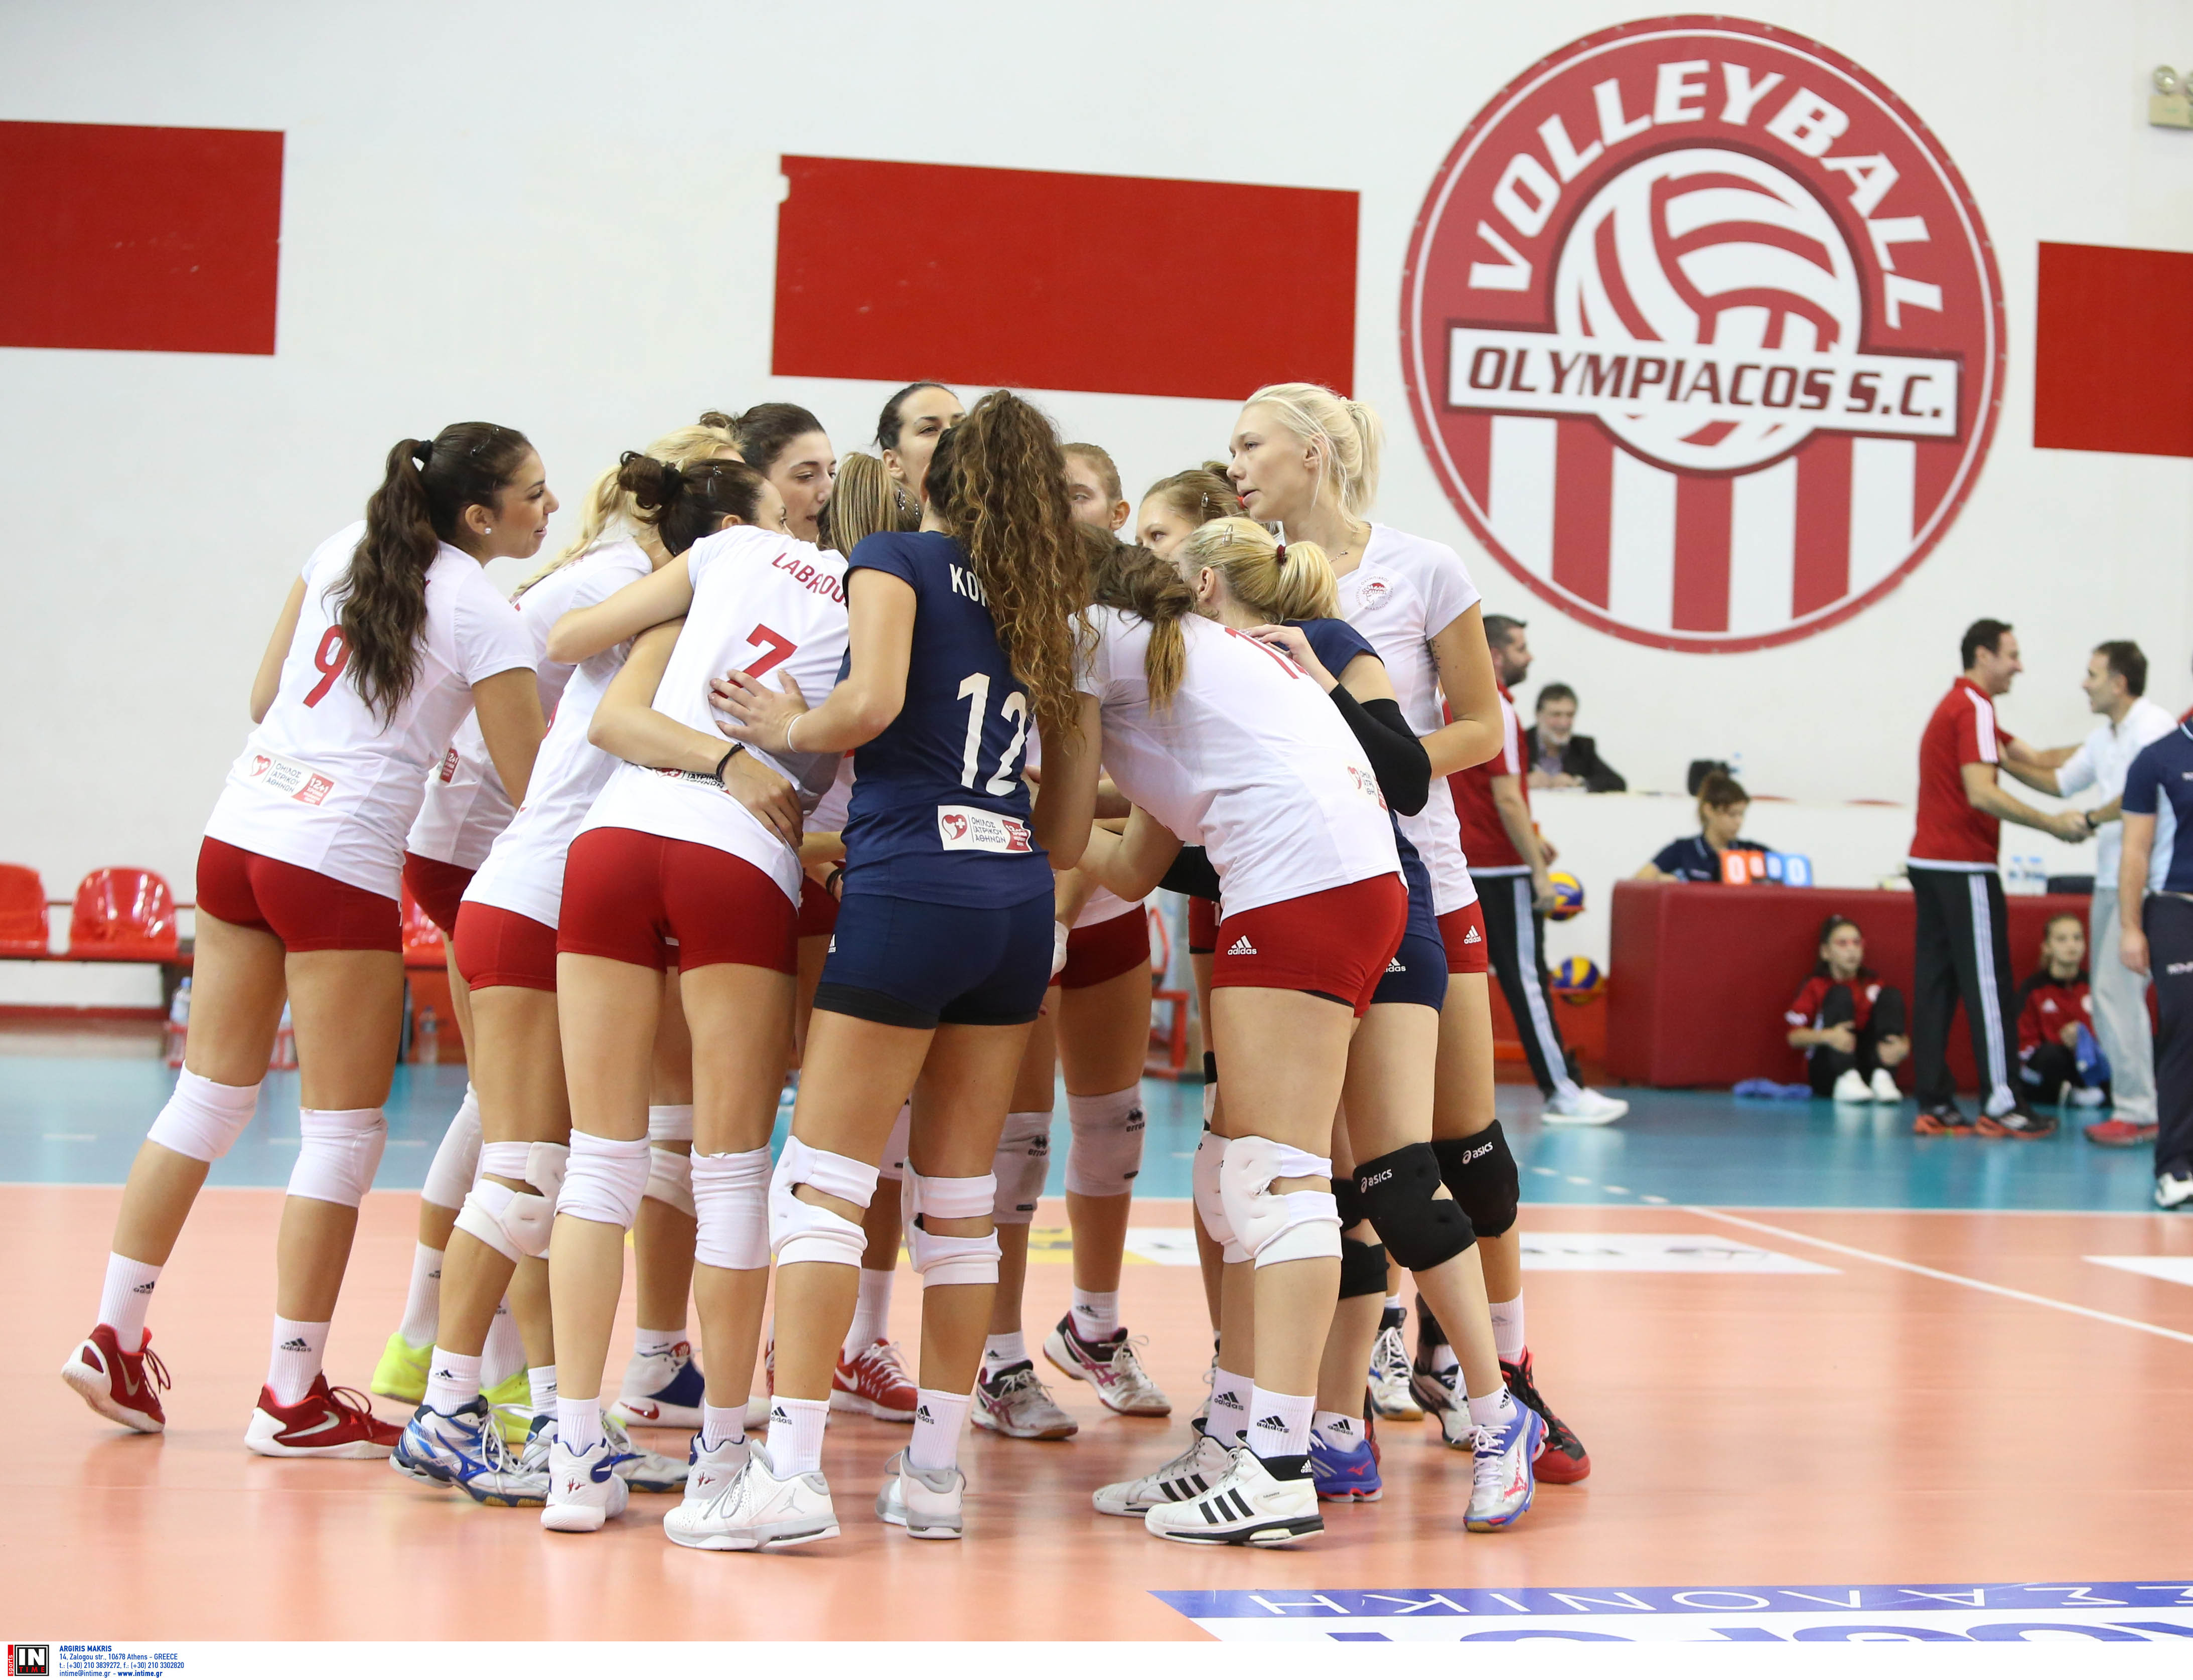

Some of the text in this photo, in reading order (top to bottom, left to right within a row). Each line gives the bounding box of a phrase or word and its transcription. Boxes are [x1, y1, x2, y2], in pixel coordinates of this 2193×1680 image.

[1468, 59, 1943, 330] VOLLEYBALL
[1469, 346, 1942, 418] OLYMPIACOS S.C.
[772, 552, 847, 607] LABROU
[303, 625, 353, 708] 9
[714, 624, 798, 699] 7
[957, 672, 1027, 796] 12
[971, 817, 996, 828] ΟΜΙΛΟΣ
[973, 825, 1003, 836] ΙΑΤΡΙΚΟΥ
[975, 834, 1006, 844] ΑΘΗΝΩΝ
[1464, 936, 1482, 944] adidas
[1227, 947, 1258, 955] adidas
[1472, 1141, 1494, 1159] asics
[1368, 1168, 1393, 1186] asics
[280, 1344, 312, 1352] adidas
[1214, 1398, 1244, 1411] adidas
[1256, 1422, 1290, 1433] adidas
[1328, 1425, 1354, 1435] adidas
